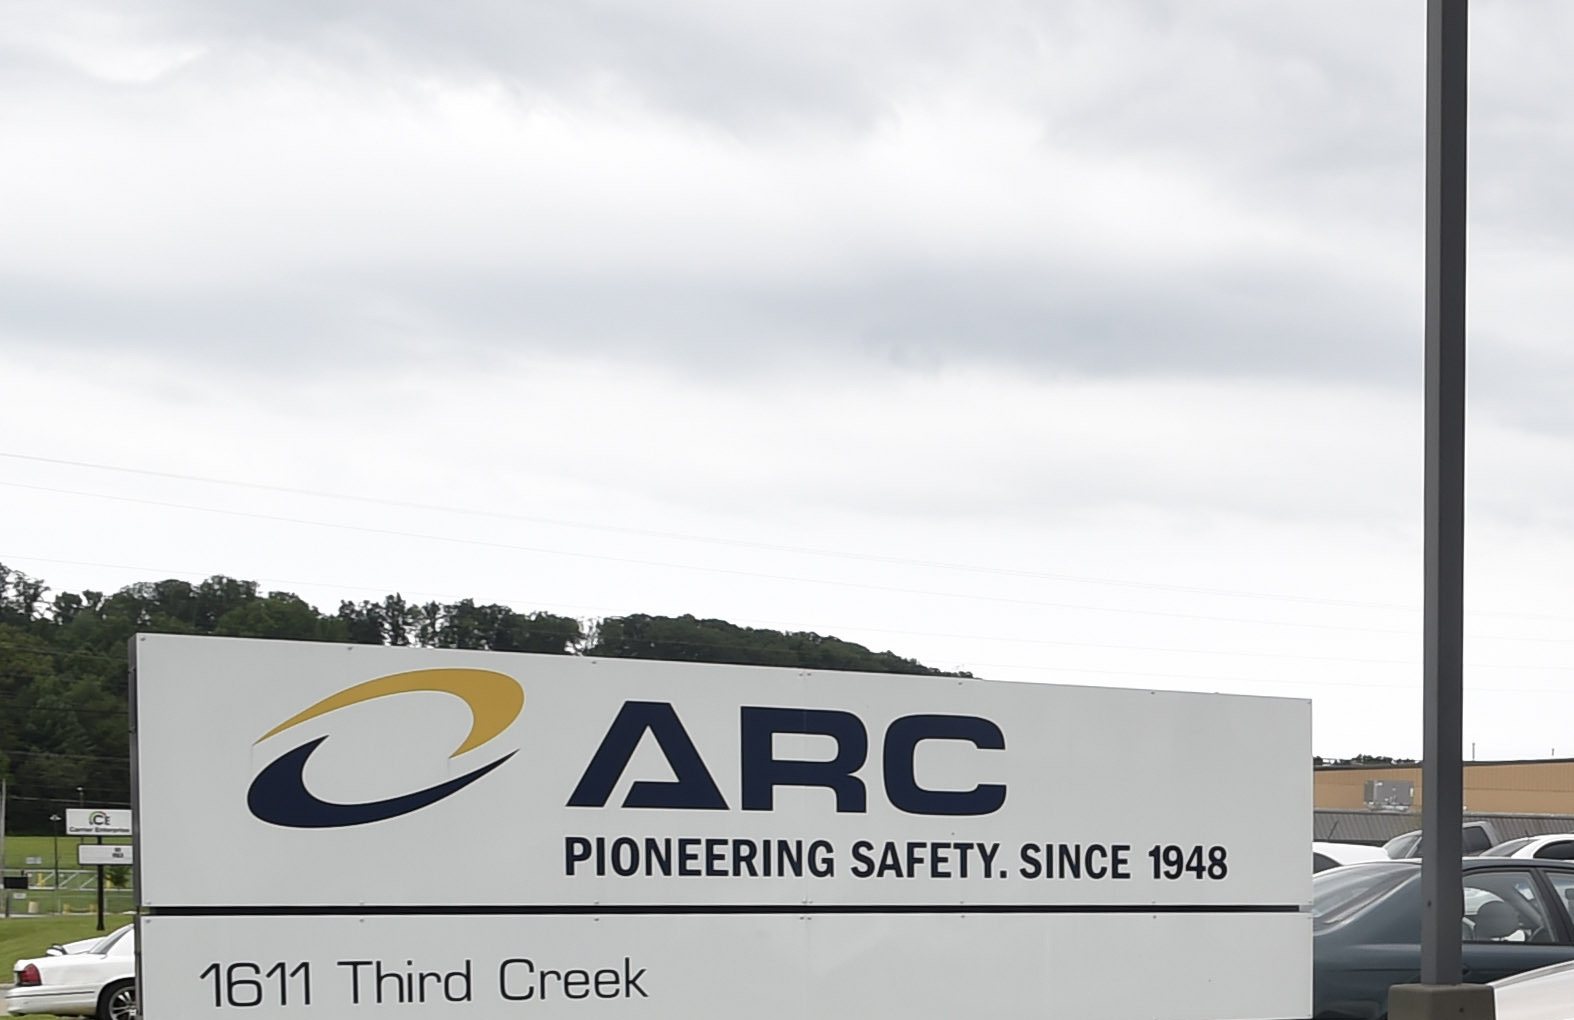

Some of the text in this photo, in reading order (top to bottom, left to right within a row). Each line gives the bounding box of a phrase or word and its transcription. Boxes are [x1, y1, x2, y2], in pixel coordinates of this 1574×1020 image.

[565, 700, 1007, 817] ARC
[565, 836, 1228, 880] PIONEERING SAFETY. SINCE 1948
[199, 957, 648, 1008] 1611 Third Creek
